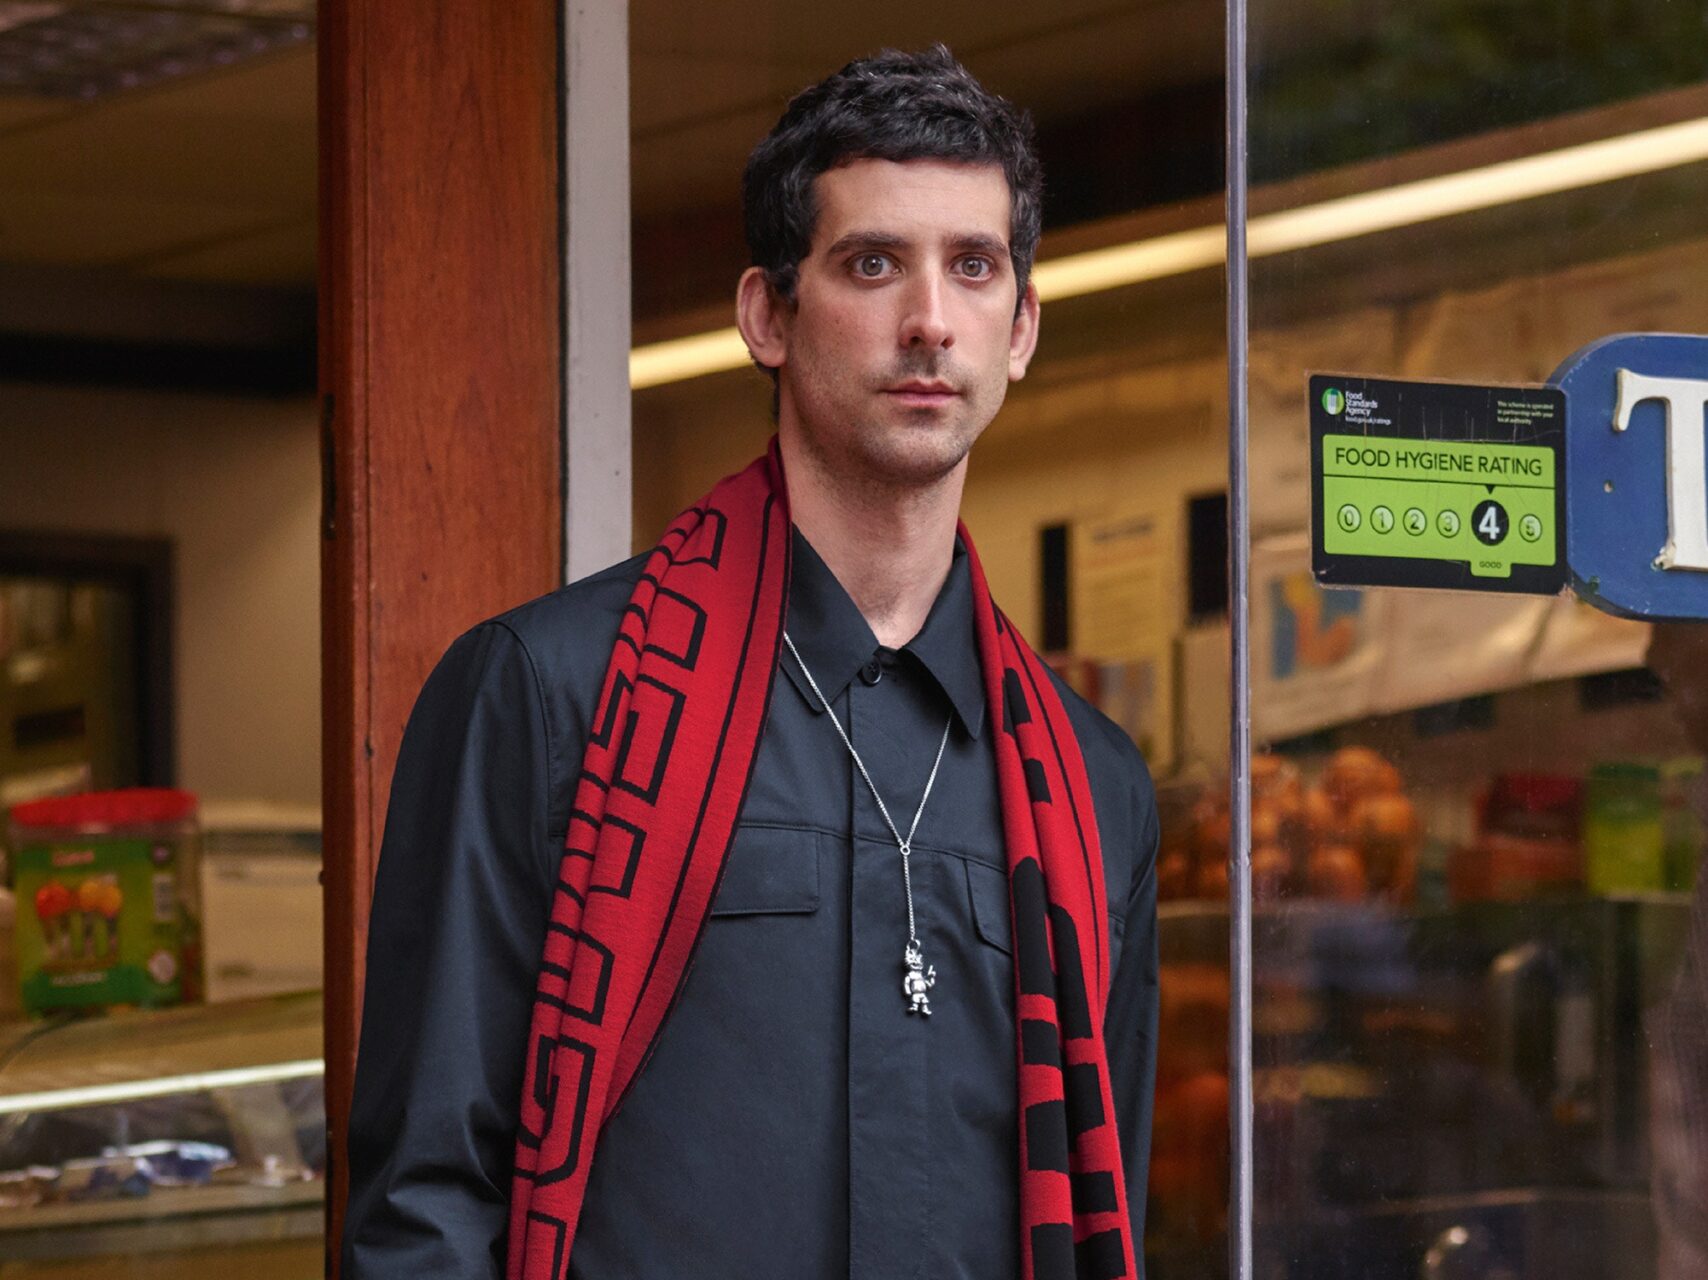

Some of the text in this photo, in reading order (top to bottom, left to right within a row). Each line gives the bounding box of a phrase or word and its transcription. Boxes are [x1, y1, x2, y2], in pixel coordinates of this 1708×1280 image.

[1345, 391, 1363, 400] Food
[1345, 400, 1378, 409] Standards
[1345, 407, 1371, 417] Agency
[1335, 447, 1543, 477] FOOD HYGIENE RATING
[1344, 510, 1355, 528] 0
[1409, 514, 1420, 531] 2
[1443, 515, 1454, 533] 3
[1478, 506, 1500, 540] 4
[1525, 520, 1536, 538] 5
[1478, 561, 1503, 570] GOOD
